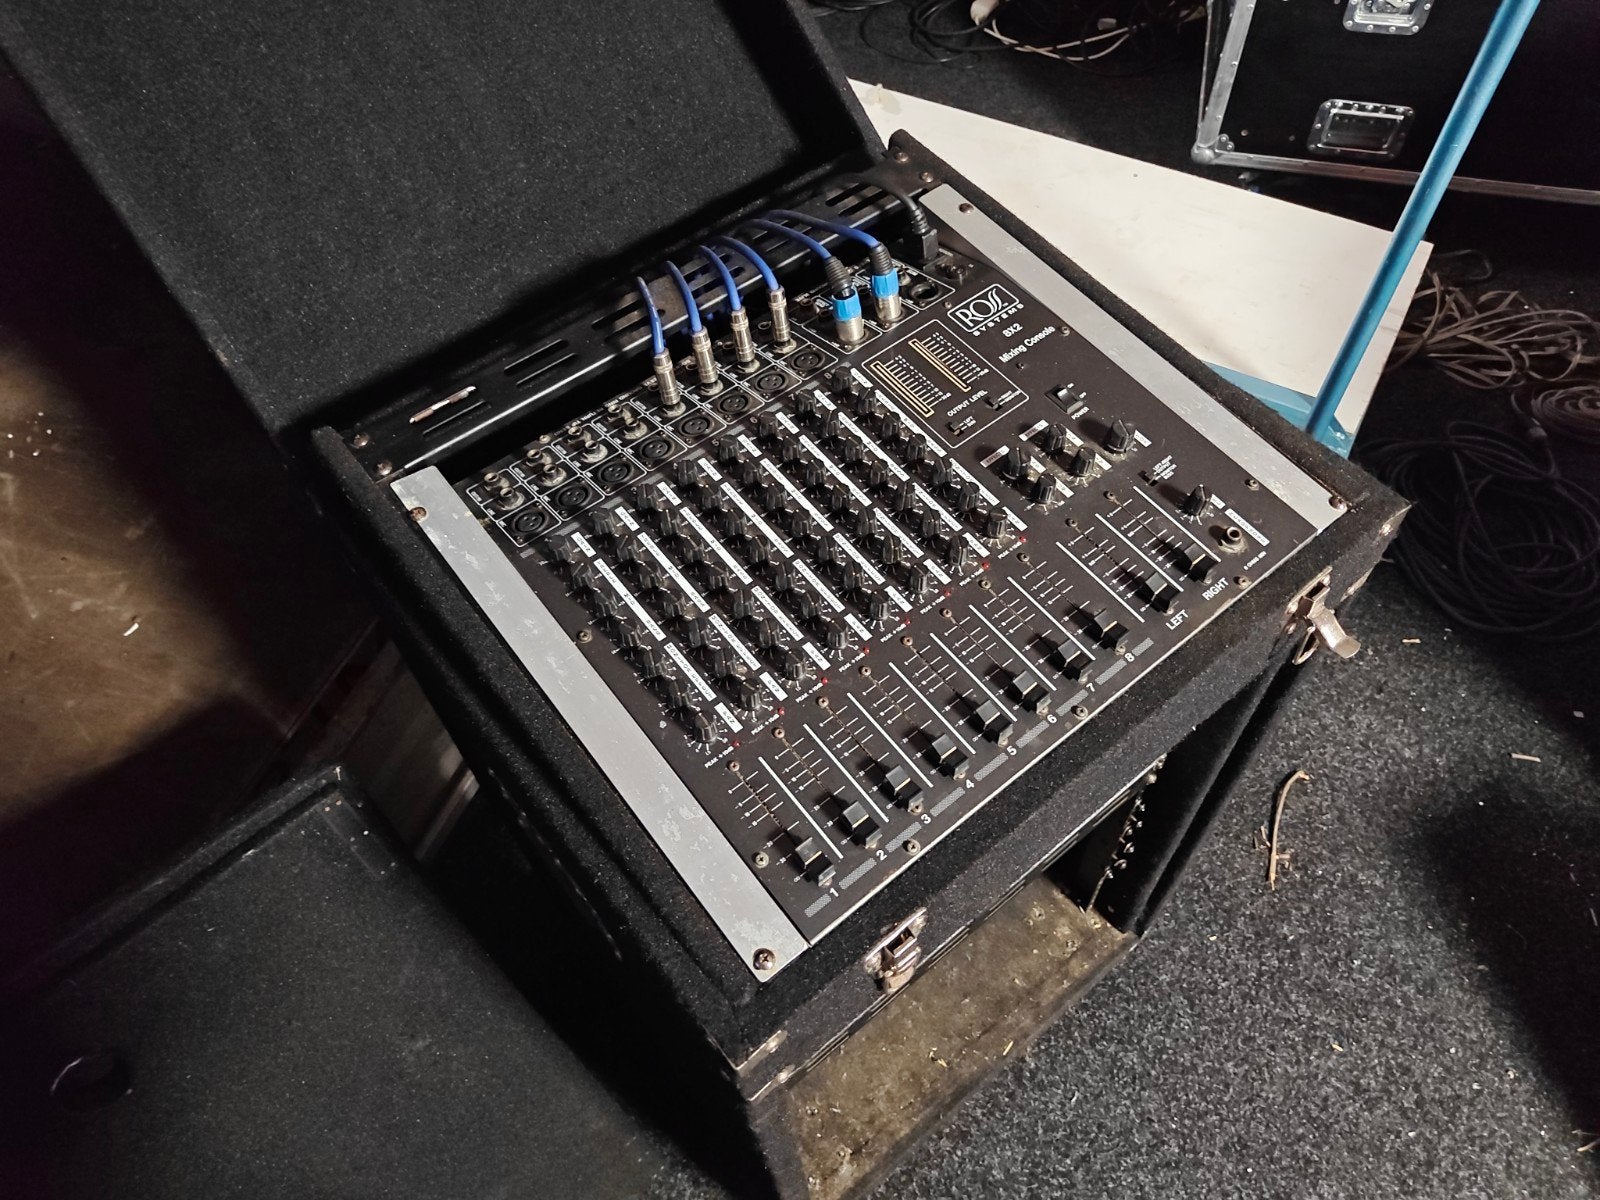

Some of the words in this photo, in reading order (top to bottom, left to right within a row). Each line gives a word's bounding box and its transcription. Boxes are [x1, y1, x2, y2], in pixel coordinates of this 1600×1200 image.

[955, 288, 1004, 327] ROSS
[973, 303, 1025, 337] SYSTEMS
[1003, 323, 1023, 339] 8X2
[999, 340, 1028, 364] Mixing
[1024, 325, 1056, 349] Console
[947, 400, 970, 417] OUTPUT
[971, 389, 989, 403] LEVEL
[1071, 406, 1090, 420] POWER
[1202, 577, 1230, 601] RIGHT
[1165, 608, 1189, 631] LEFT
[1125, 652, 1135, 663] 8
[1086, 682, 1096, 693] 7
[1047, 714, 1057, 724] 6
[1006, 745, 1016, 756] 5
[965, 779, 975, 790] 4
[921, 813, 931, 825] 3
[876, 849, 887, 861] 2
[829, 887, 839, 898] 1
